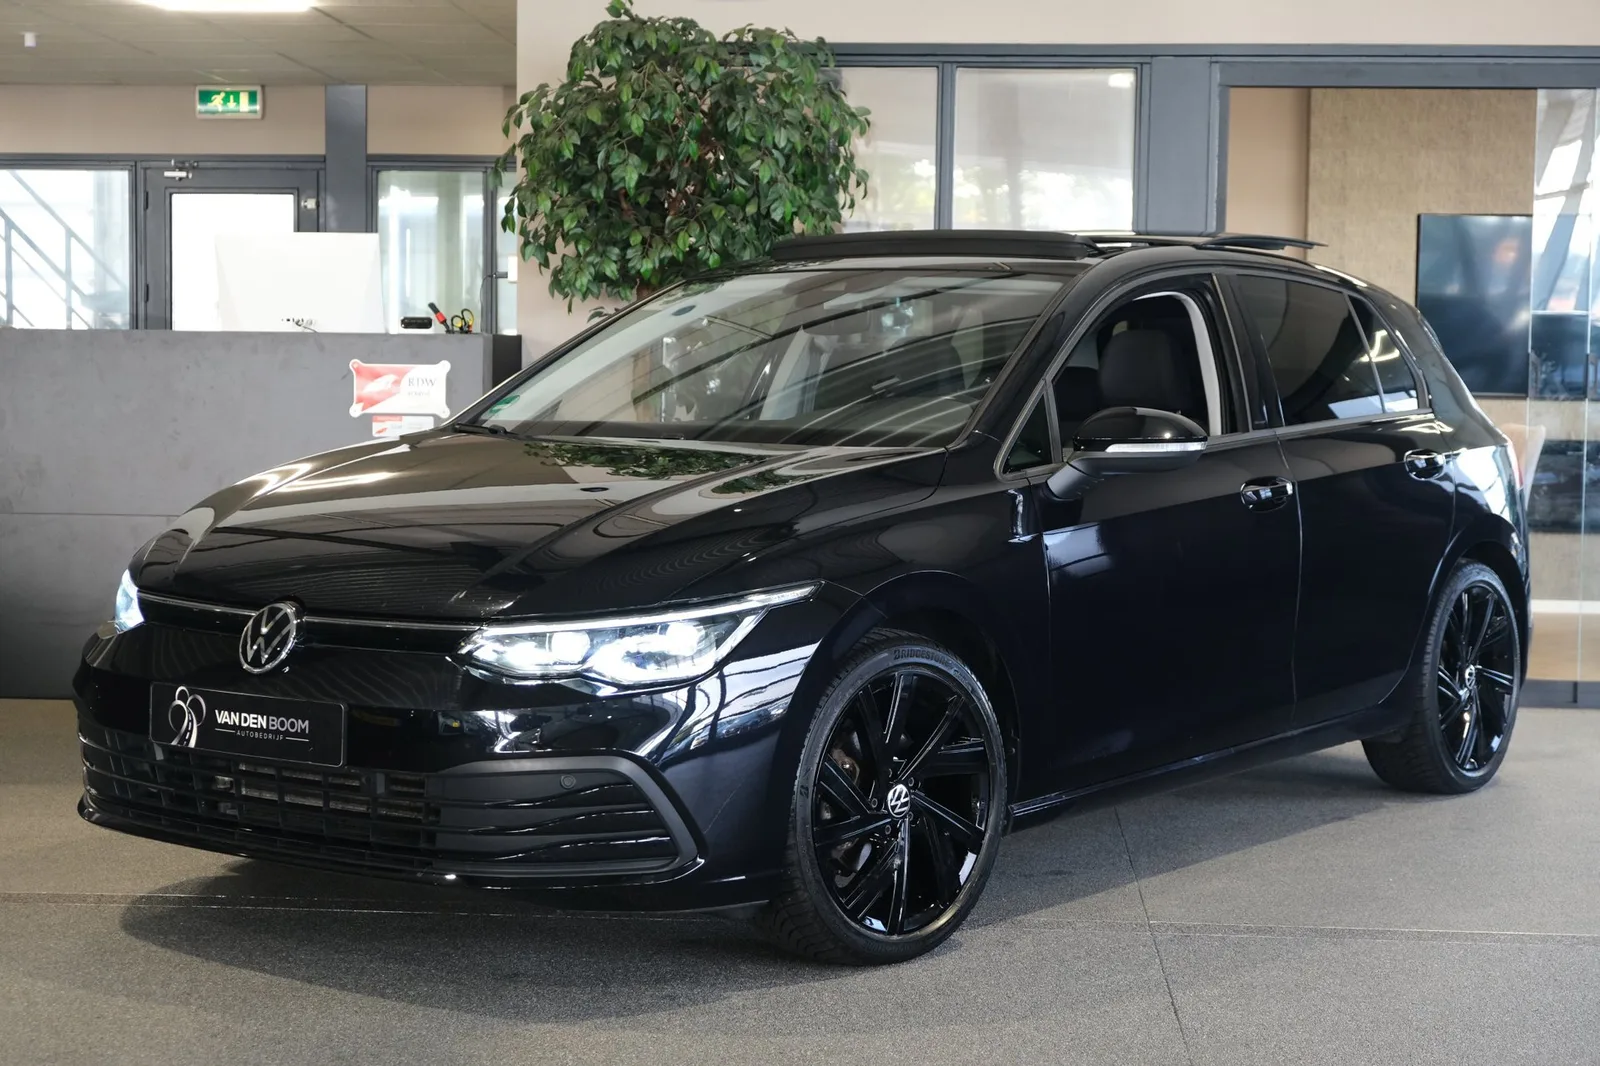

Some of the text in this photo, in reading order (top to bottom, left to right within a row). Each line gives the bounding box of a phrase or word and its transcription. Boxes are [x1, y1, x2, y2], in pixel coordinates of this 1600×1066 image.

[407, 377, 437, 387] RDW
[241, 604, 296, 672] VW
[214, 709, 310, 734] VAN DEN BOOM
[236, 730, 284, 741] AUTOBEDRIJF
